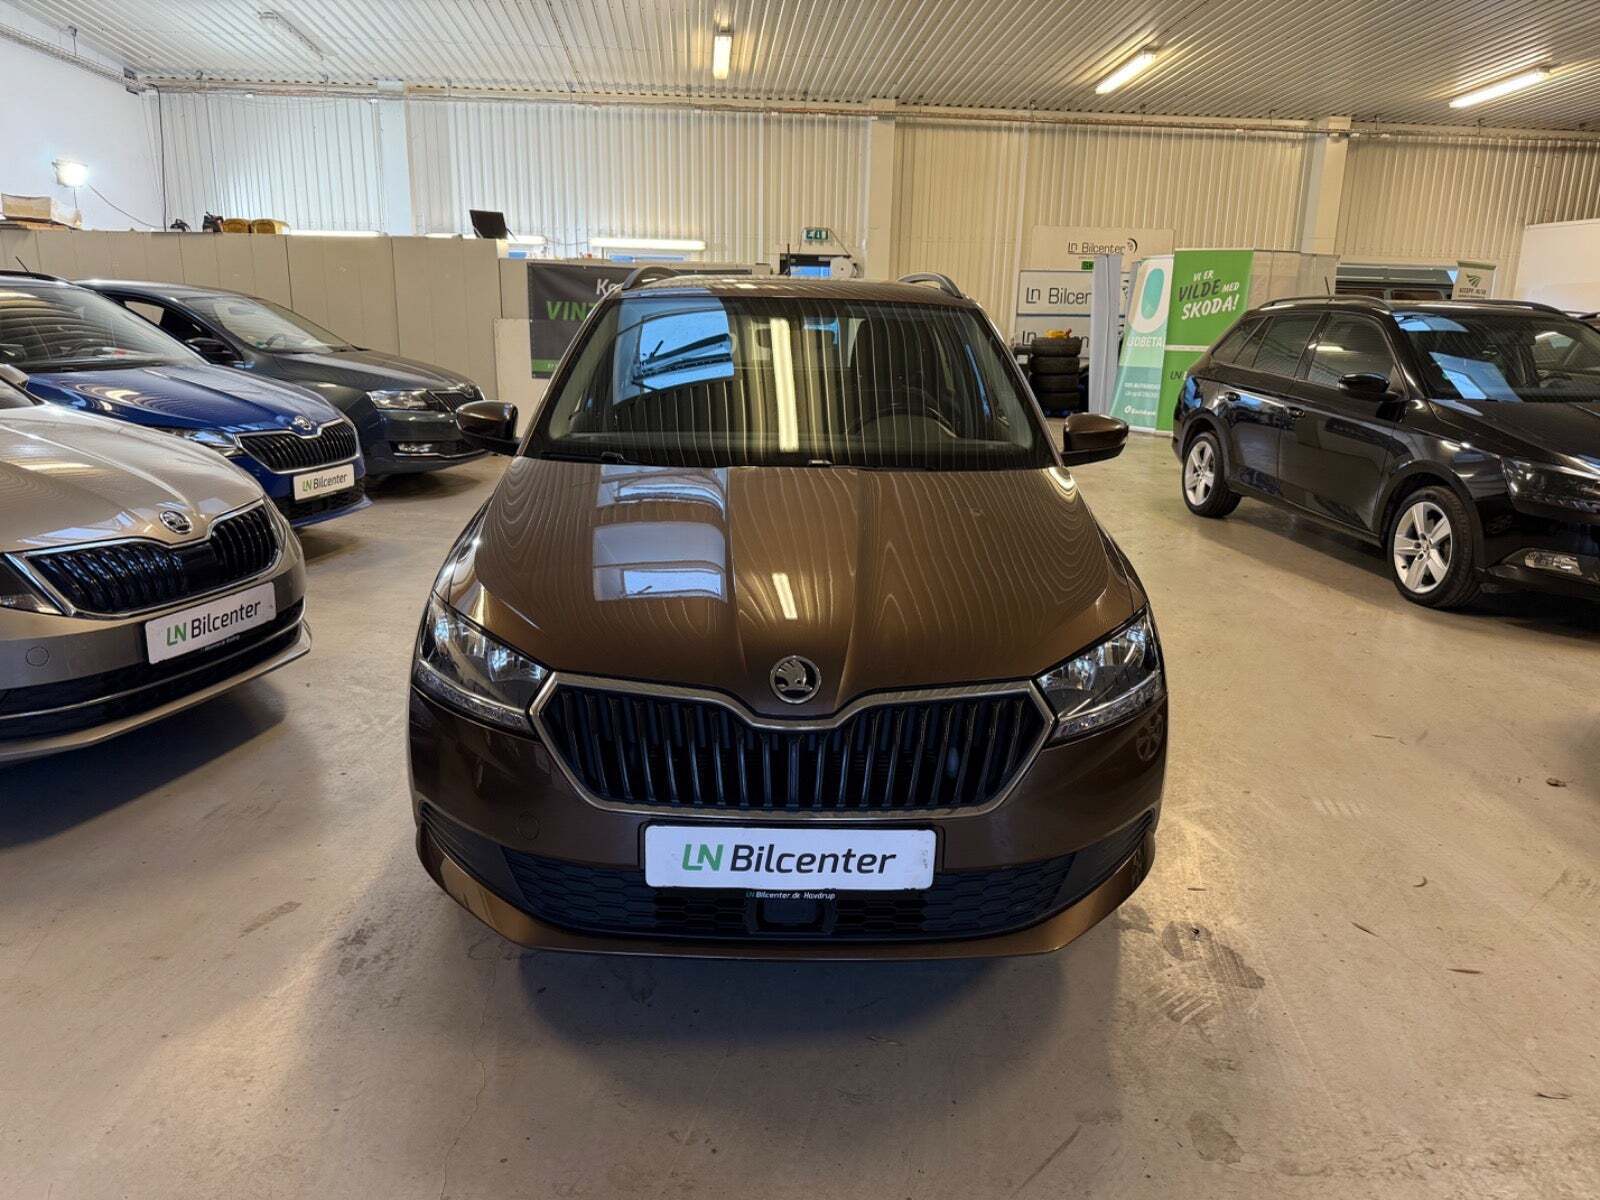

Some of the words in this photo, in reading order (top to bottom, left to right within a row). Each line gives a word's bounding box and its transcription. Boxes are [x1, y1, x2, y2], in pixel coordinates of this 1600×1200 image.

[1081, 242, 1125, 254] Bilcenter
[1203, 270, 1215, 280] ER
[1178, 279, 1222, 302] VILDE
[1221, 281, 1240, 293] MED
[1181, 293, 1240, 320] SKODA!
[313, 474, 348, 490] Bilcenter
[166, 622, 187, 647] LN
[191, 601, 262, 639] Bilcenter
[682, 844, 724, 871] LN
[730, 844, 896, 874] Bilcenter
